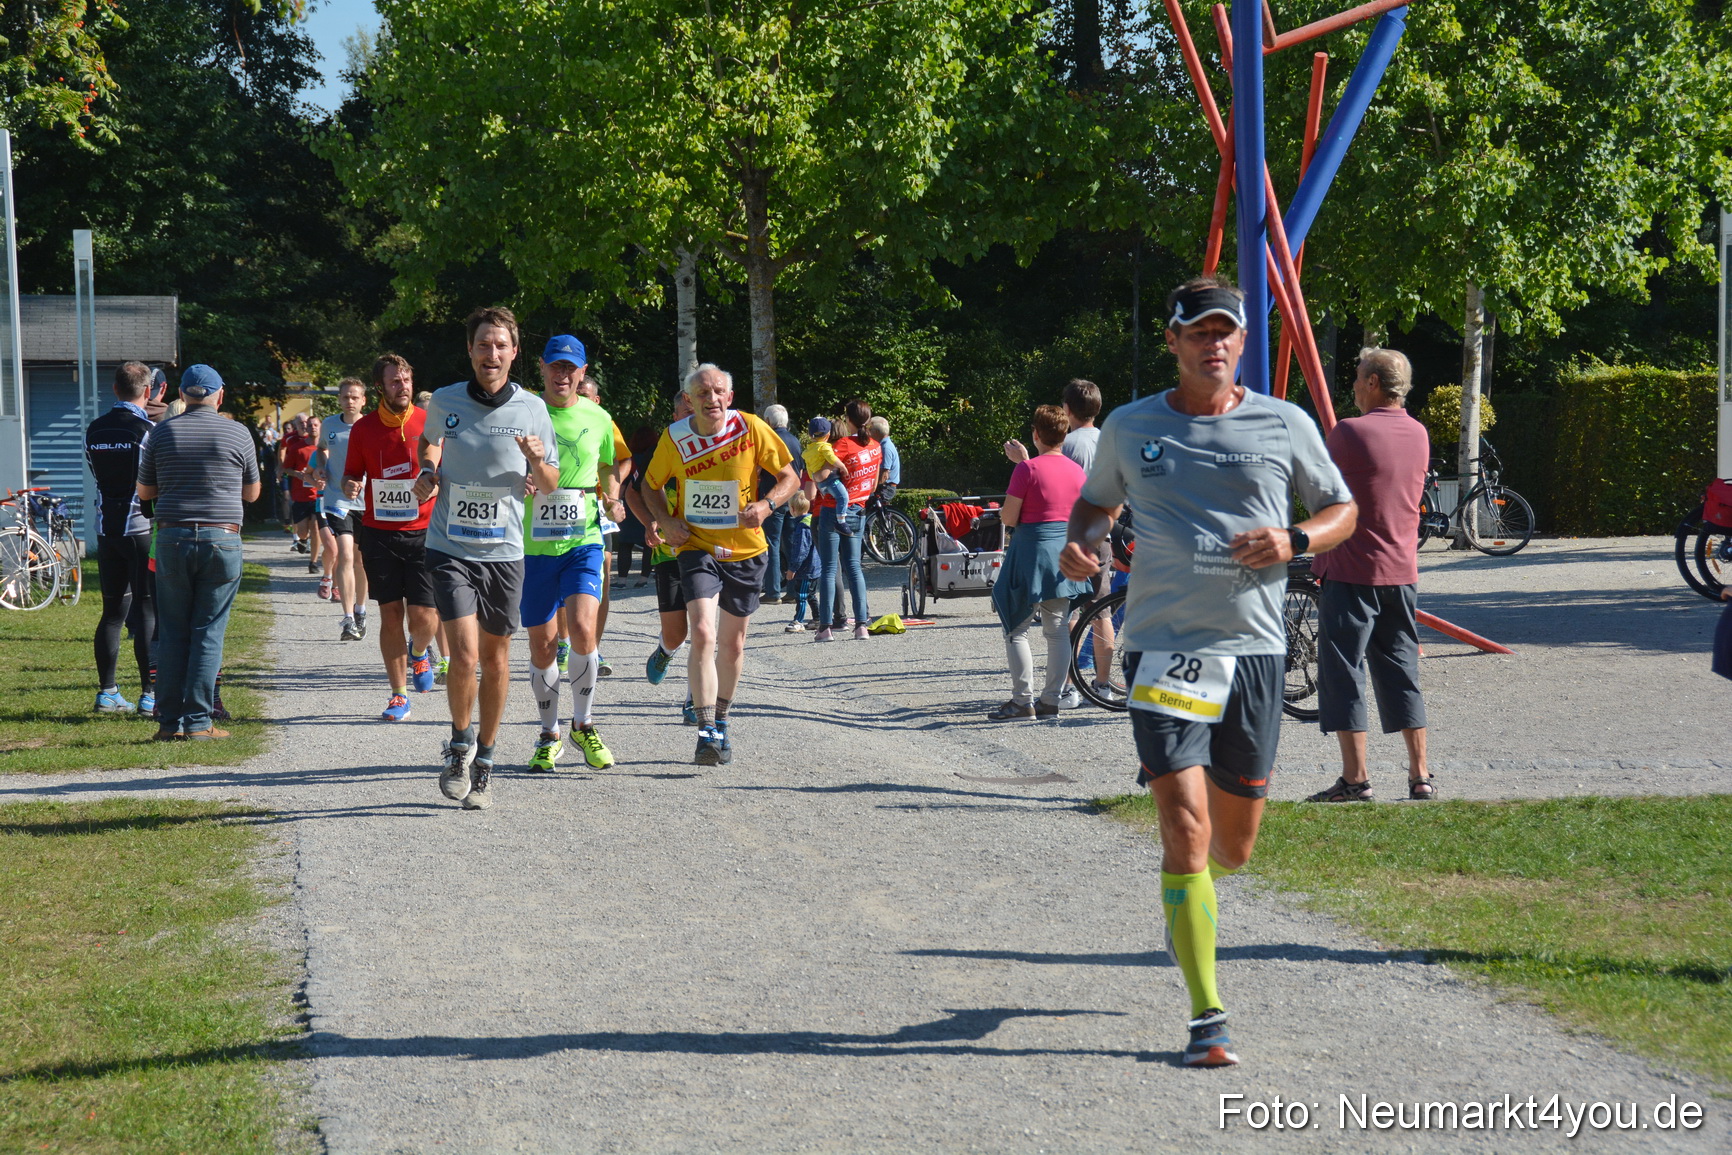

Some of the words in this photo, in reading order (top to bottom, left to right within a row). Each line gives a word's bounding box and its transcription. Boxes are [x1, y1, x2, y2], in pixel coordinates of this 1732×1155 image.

[491, 427, 522, 435] BOCK
[685, 457, 717, 477] MAX
[719, 439, 754, 462] BÖGL
[1215, 453, 1264, 464] BOCK
[1141, 465, 1166, 473] PARTL
[379, 491, 411, 504] 2440
[692, 494, 730, 509] 2423
[457, 501, 498, 519] 2631
[540, 505, 578, 520] 2138
[461, 527, 493, 538] Veronika
[1194, 553, 1241, 565] Neumark
[1193, 565, 1241, 578] Stadtlauf
[1166, 653, 1202, 683] 28
[1160, 692, 1193, 710] Bernd
